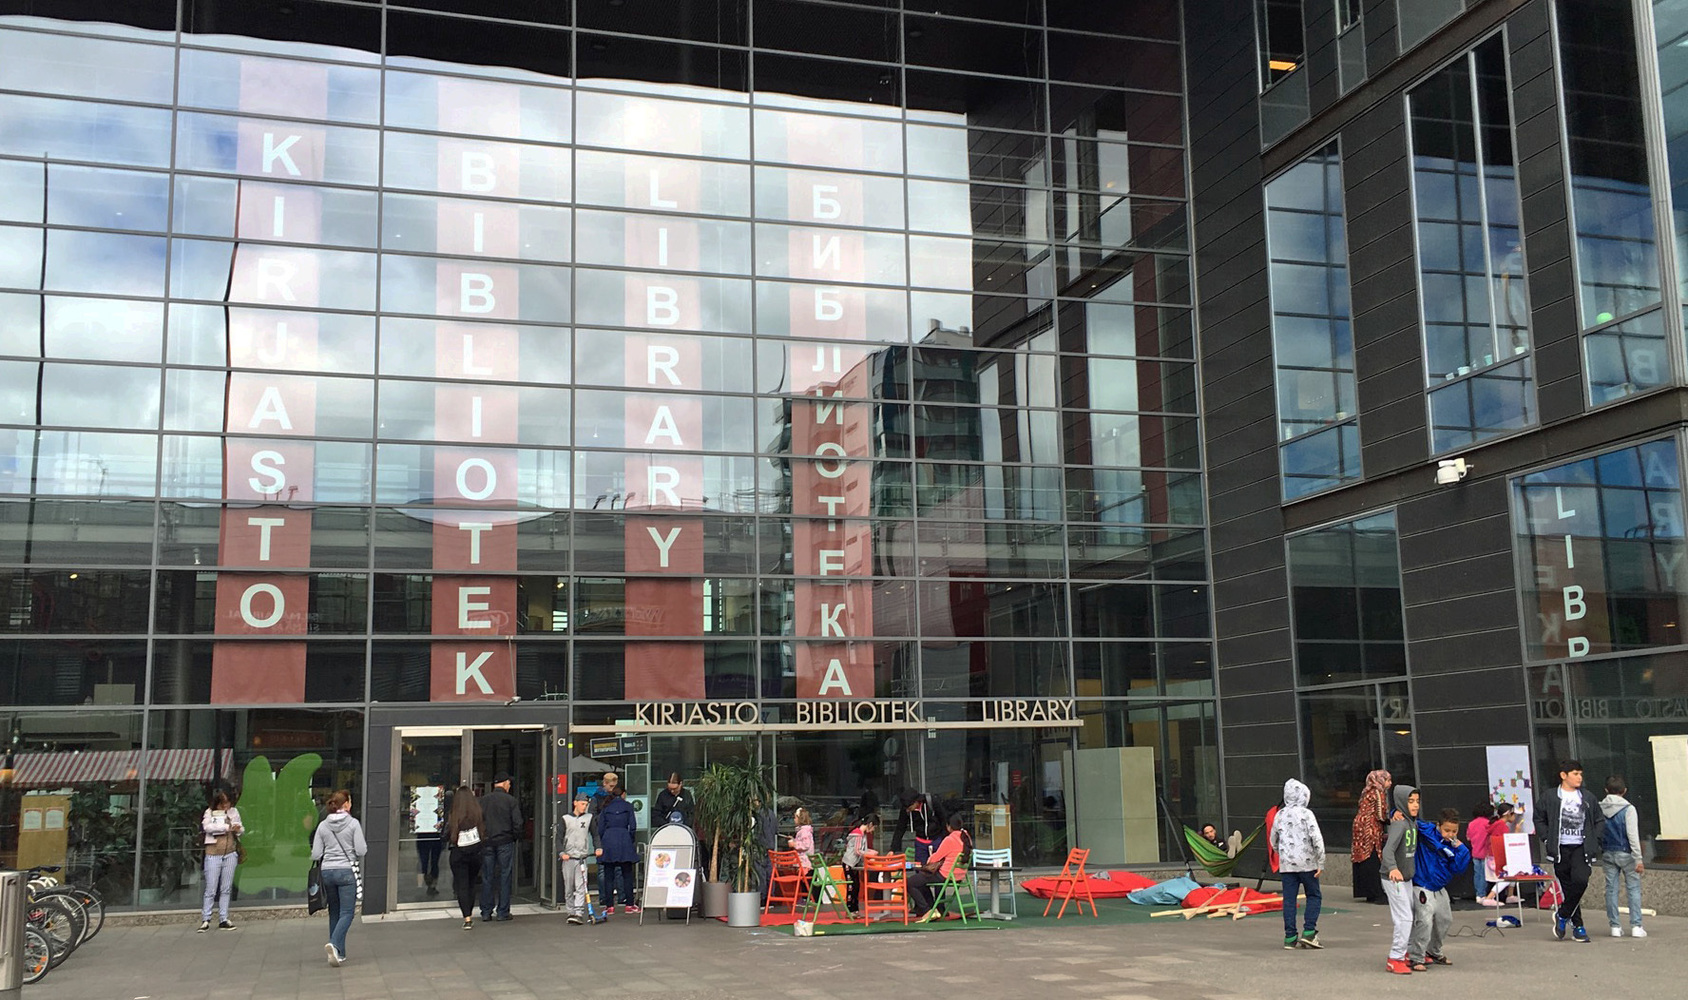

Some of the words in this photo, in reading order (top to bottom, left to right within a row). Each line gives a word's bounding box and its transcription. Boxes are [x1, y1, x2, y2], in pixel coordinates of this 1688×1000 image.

[239, 132, 302, 629] KIRJASTO
[455, 151, 497, 695] BIBLIOTEK
[646, 169, 683, 568] LIBRARY
[812, 184, 852, 696] БИБЛИОТЕКА
[635, 702, 759, 725] KIRJASTO
[797, 701, 920, 724] BIBLIOTEK
[982, 698, 1075, 721] LIBRARY
